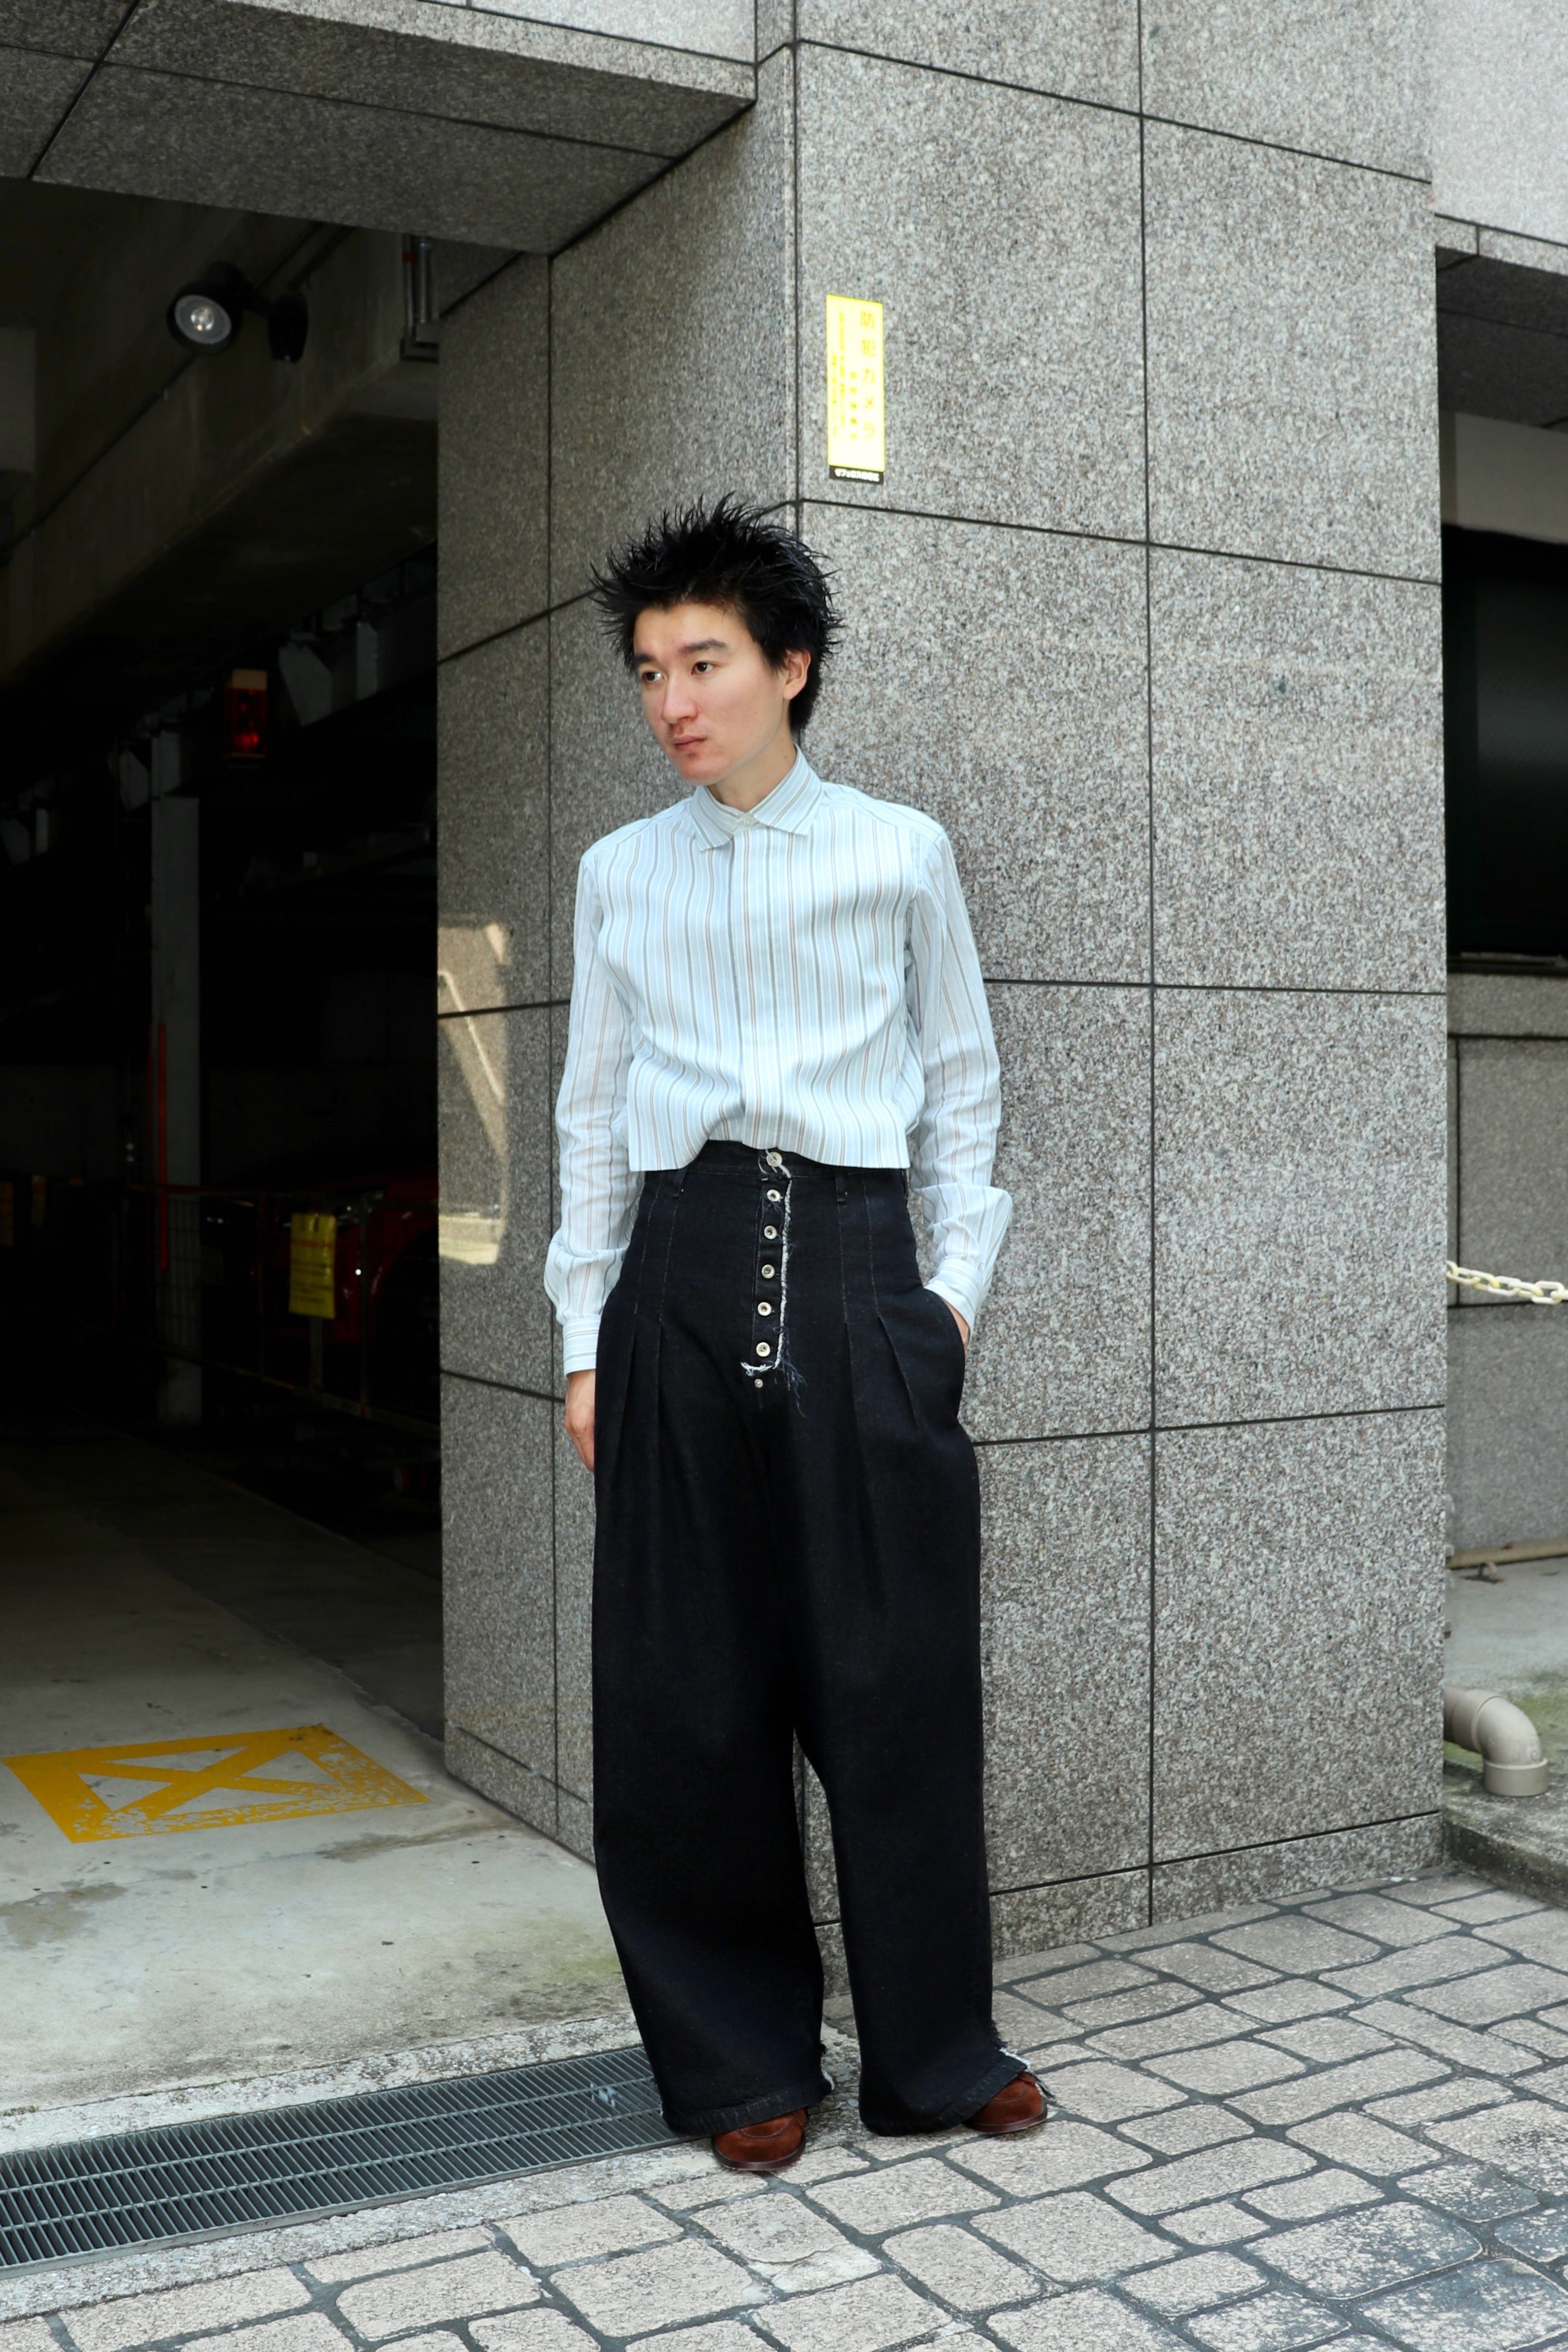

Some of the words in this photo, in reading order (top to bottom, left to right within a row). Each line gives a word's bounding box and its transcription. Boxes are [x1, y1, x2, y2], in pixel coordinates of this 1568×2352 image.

[860, 310, 876, 439] 防犯カメラ
